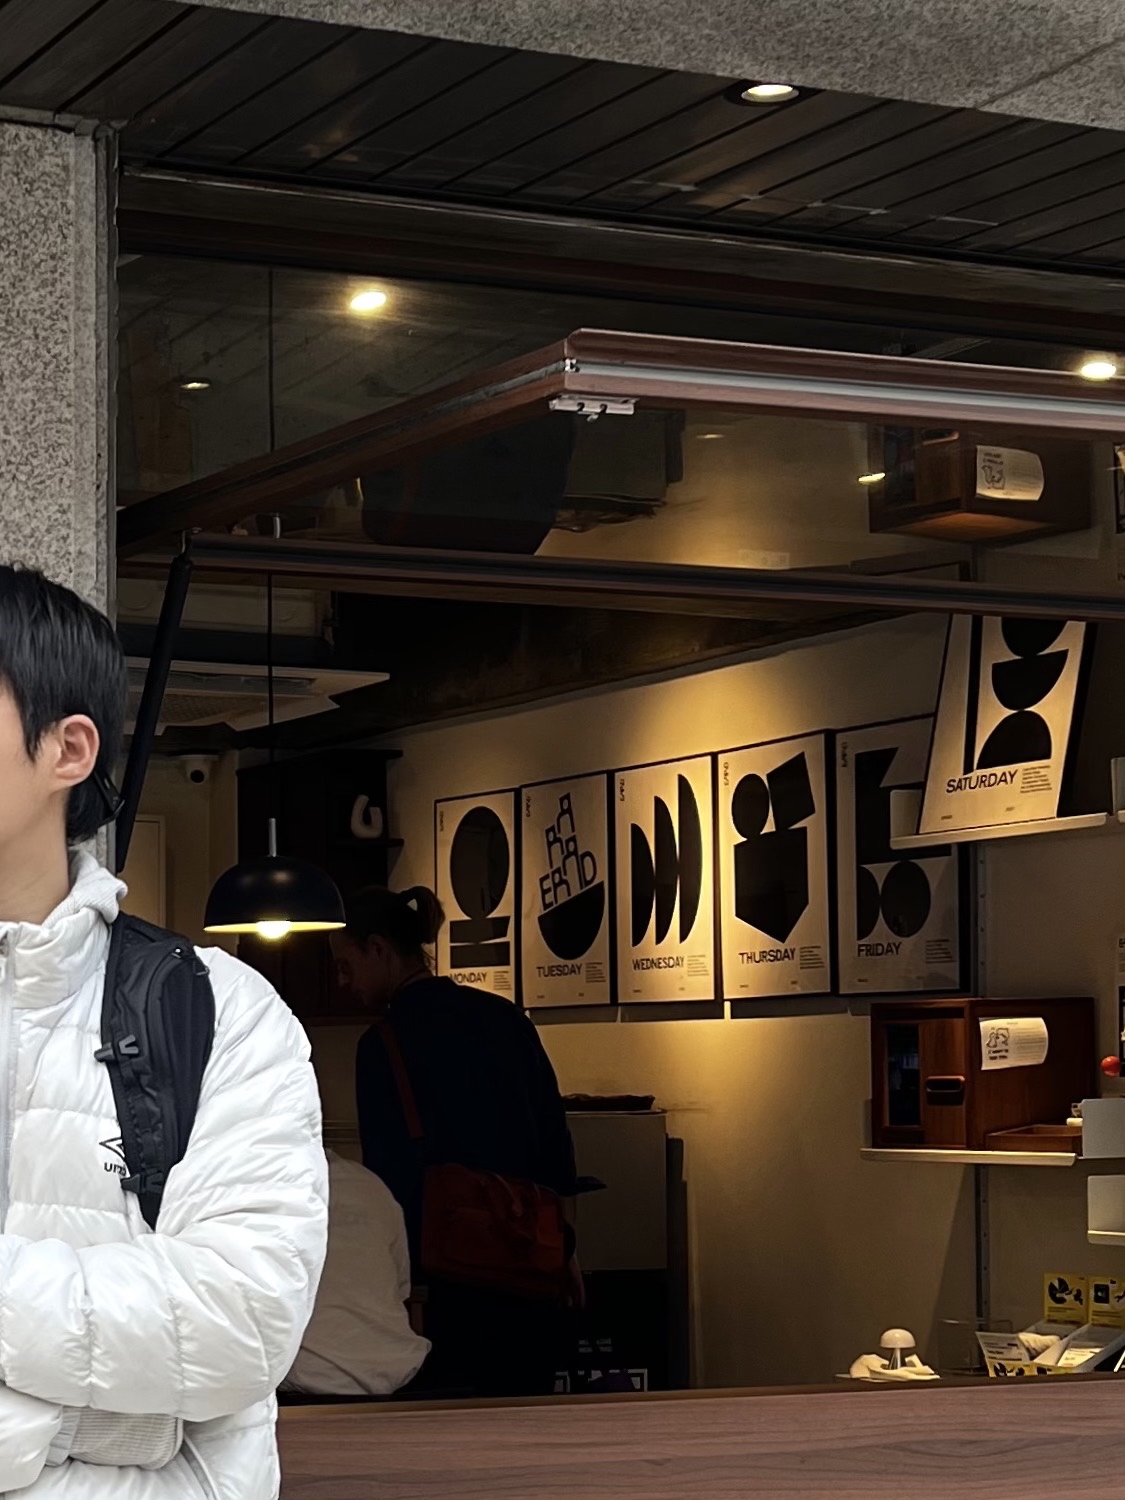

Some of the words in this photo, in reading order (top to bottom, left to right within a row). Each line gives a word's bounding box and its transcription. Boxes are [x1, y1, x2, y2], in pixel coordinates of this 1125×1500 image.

[946, 769, 1019, 794] SATURDAY
[739, 947, 796, 964] THURSDAY
[857, 941, 903, 957] FRIDAY
[536, 963, 583, 978] TUESDAY
[632, 956, 685, 971] WEDNESDAY
